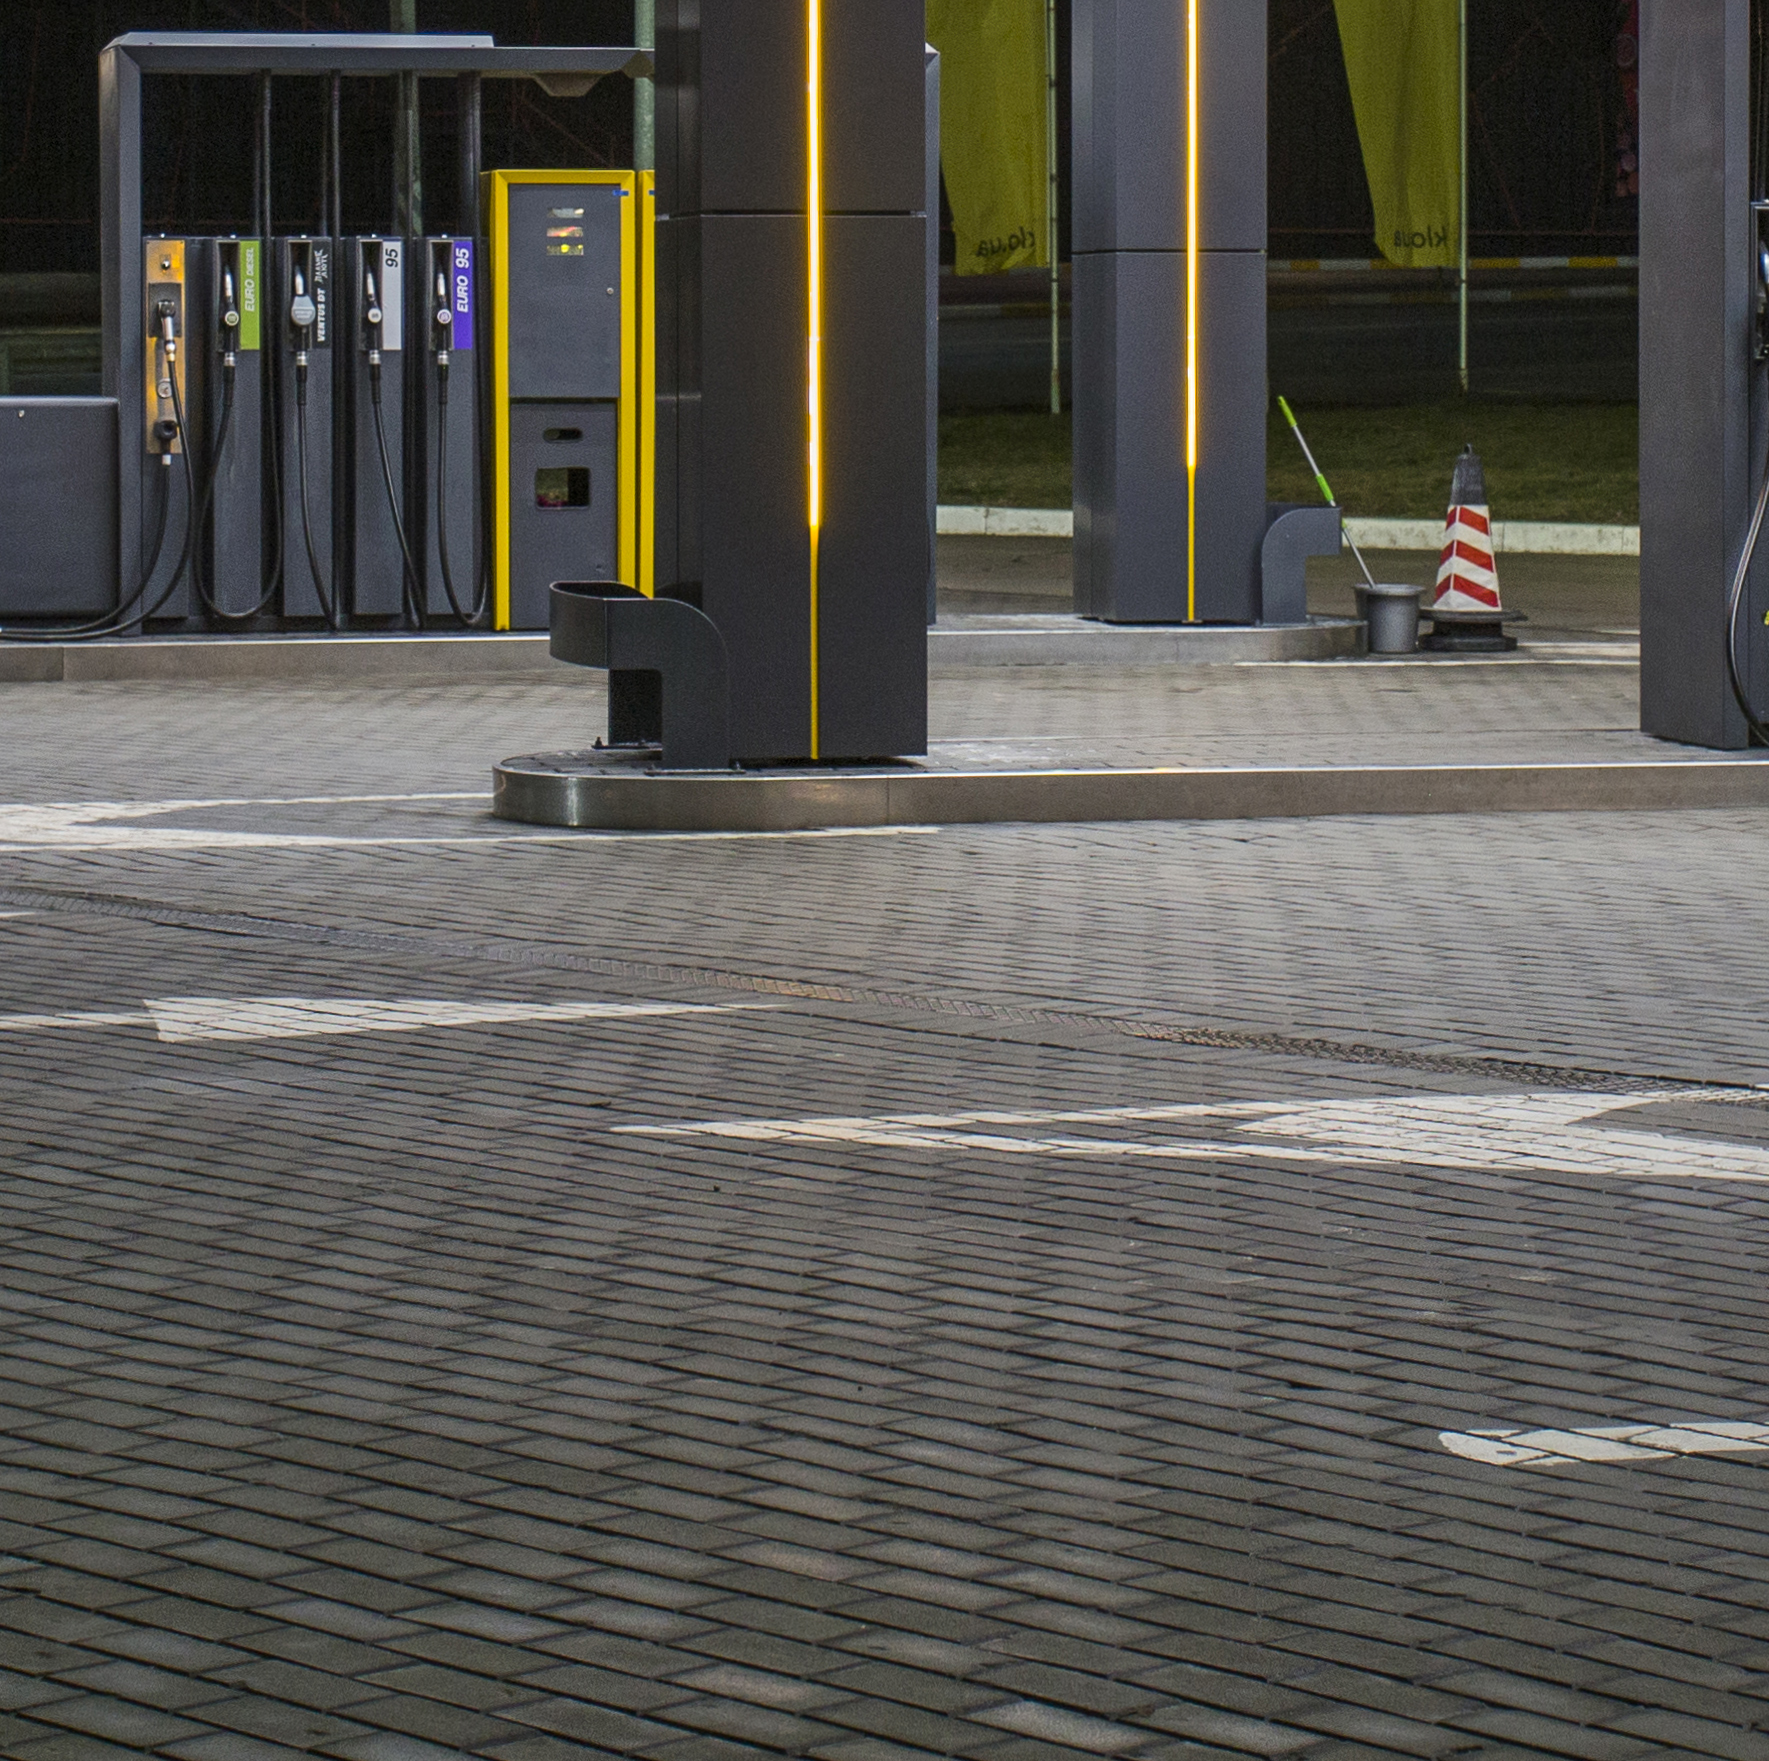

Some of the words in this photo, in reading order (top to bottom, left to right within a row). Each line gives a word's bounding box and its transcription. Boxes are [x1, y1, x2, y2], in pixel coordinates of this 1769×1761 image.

[385, 248, 398, 268] 95
[455, 248, 469, 269] 95
[245, 279, 255, 312] EURO
[317, 288, 326, 302] DT
[457, 275, 468, 313] EURO
[317, 303, 326, 342] VENTUS
